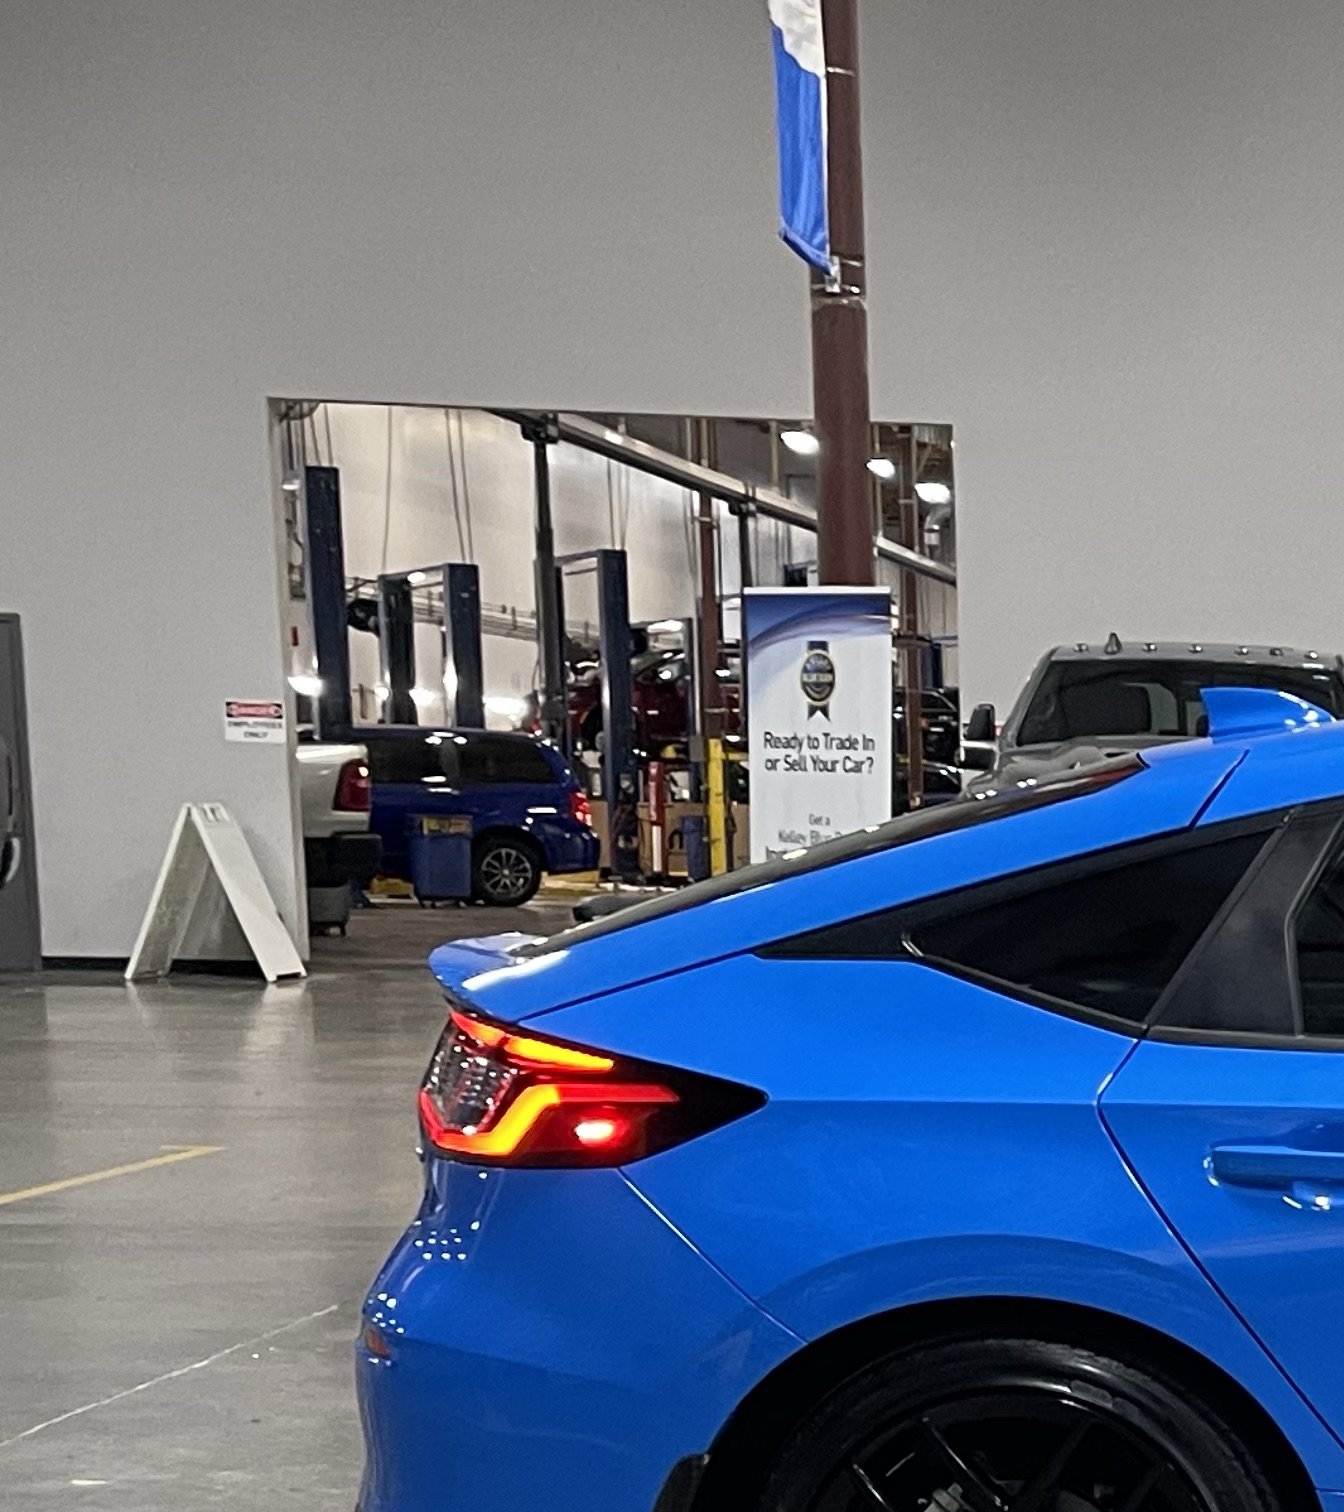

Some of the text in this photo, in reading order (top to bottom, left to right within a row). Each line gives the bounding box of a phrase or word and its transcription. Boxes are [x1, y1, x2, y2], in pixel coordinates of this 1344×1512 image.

[764, 731, 876, 753] Ready to Trade In
[764, 754, 875, 775] or Sell Your Car?
